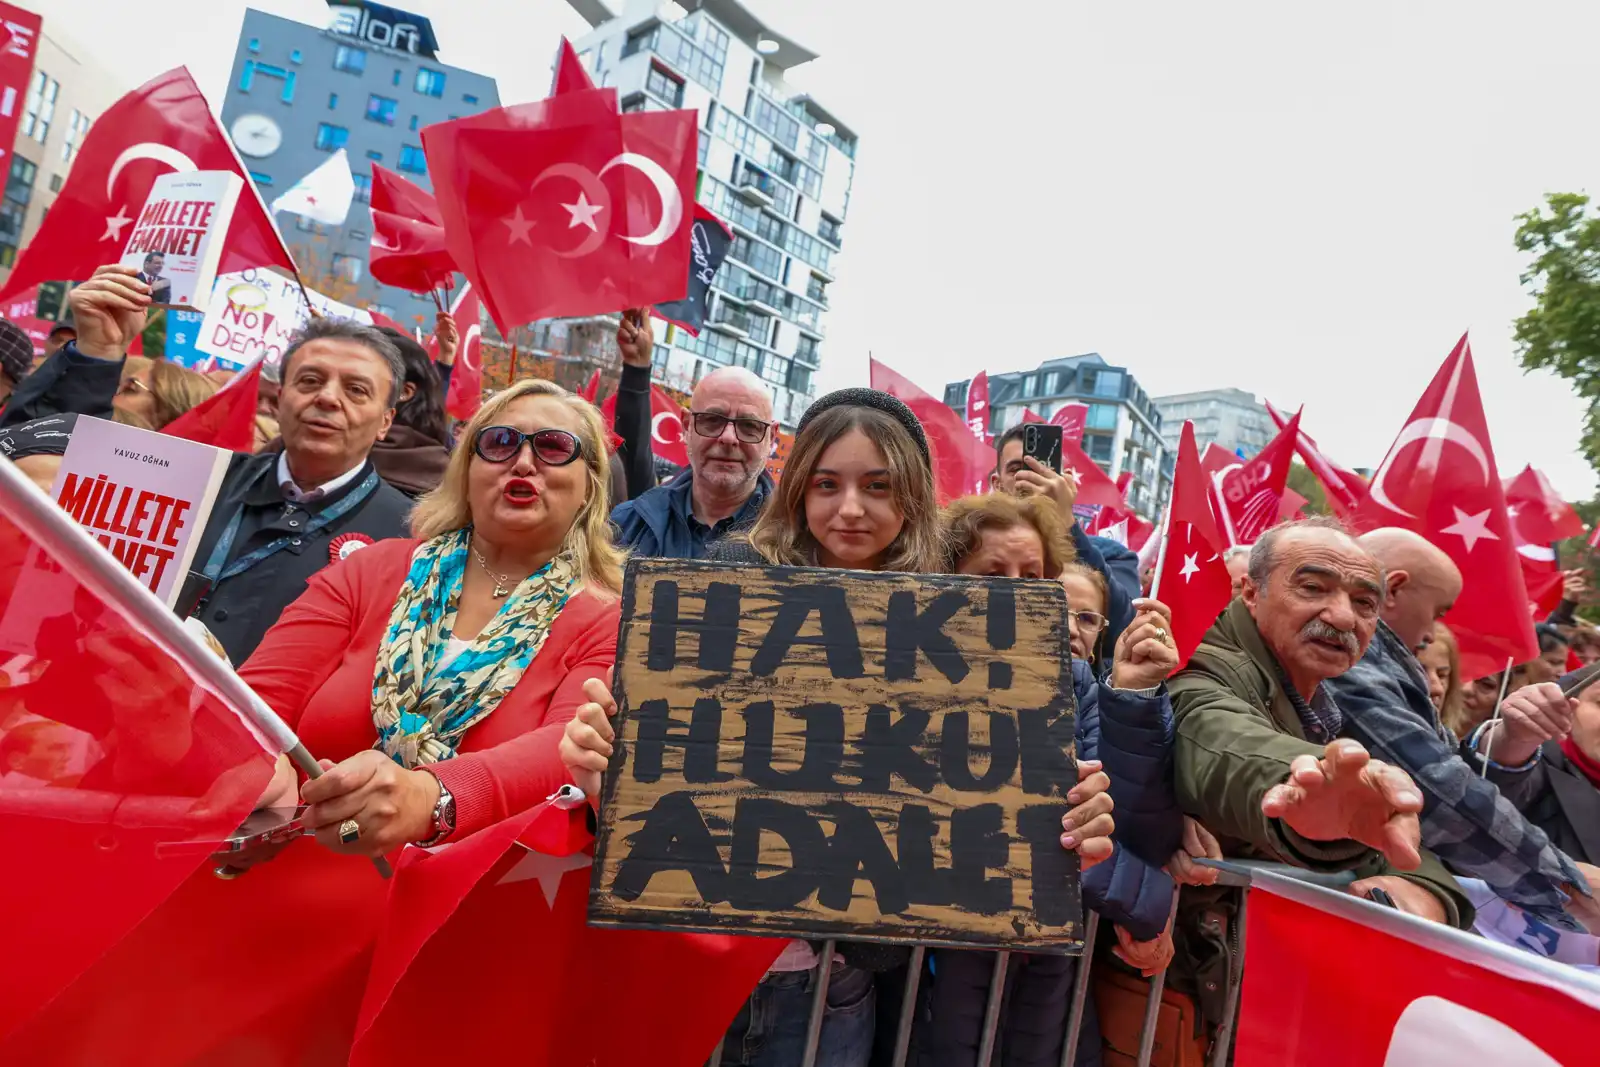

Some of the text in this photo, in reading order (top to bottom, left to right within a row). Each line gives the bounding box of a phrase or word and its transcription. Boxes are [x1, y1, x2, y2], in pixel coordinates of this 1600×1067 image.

[329, 5, 420, 54] aloft
[138, 198, 215, 227] MİLLETE
[126, 228, 207, 257] EMANET
[113, 447, 170, 468] YAVUZ OĞHAN
[57, 472, 191, 548] MİLLETE
[646, 578, 1018, 690] HAK!
